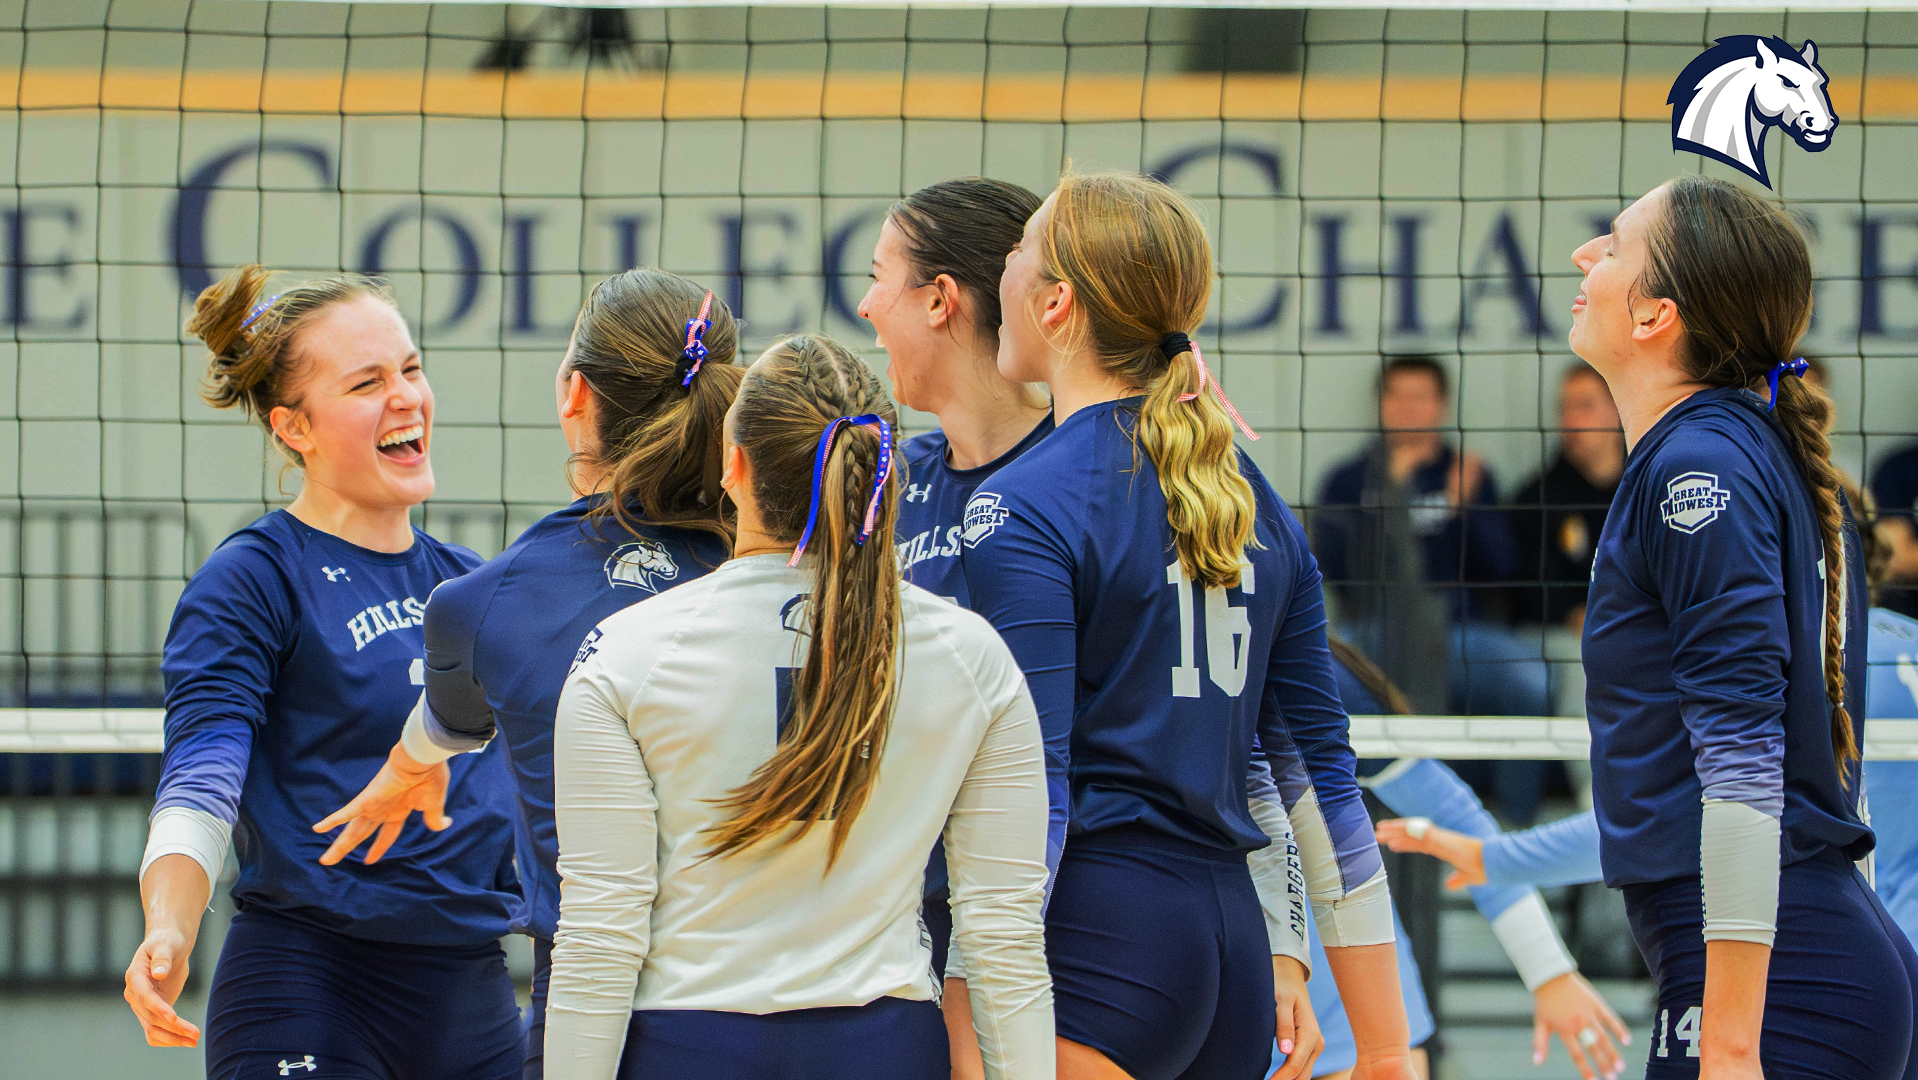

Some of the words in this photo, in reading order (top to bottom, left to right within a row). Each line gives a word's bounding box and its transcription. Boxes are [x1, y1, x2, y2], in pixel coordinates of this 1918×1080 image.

[1662, 492, 1728, 518] MIDWEST
[1674, 487, 1711, 502] GREAT
[965, 508, 1007, 531] IDWEST
[1167, 556, 1256, 698] 16
[1657, 1006, 1702, 1058] 14
